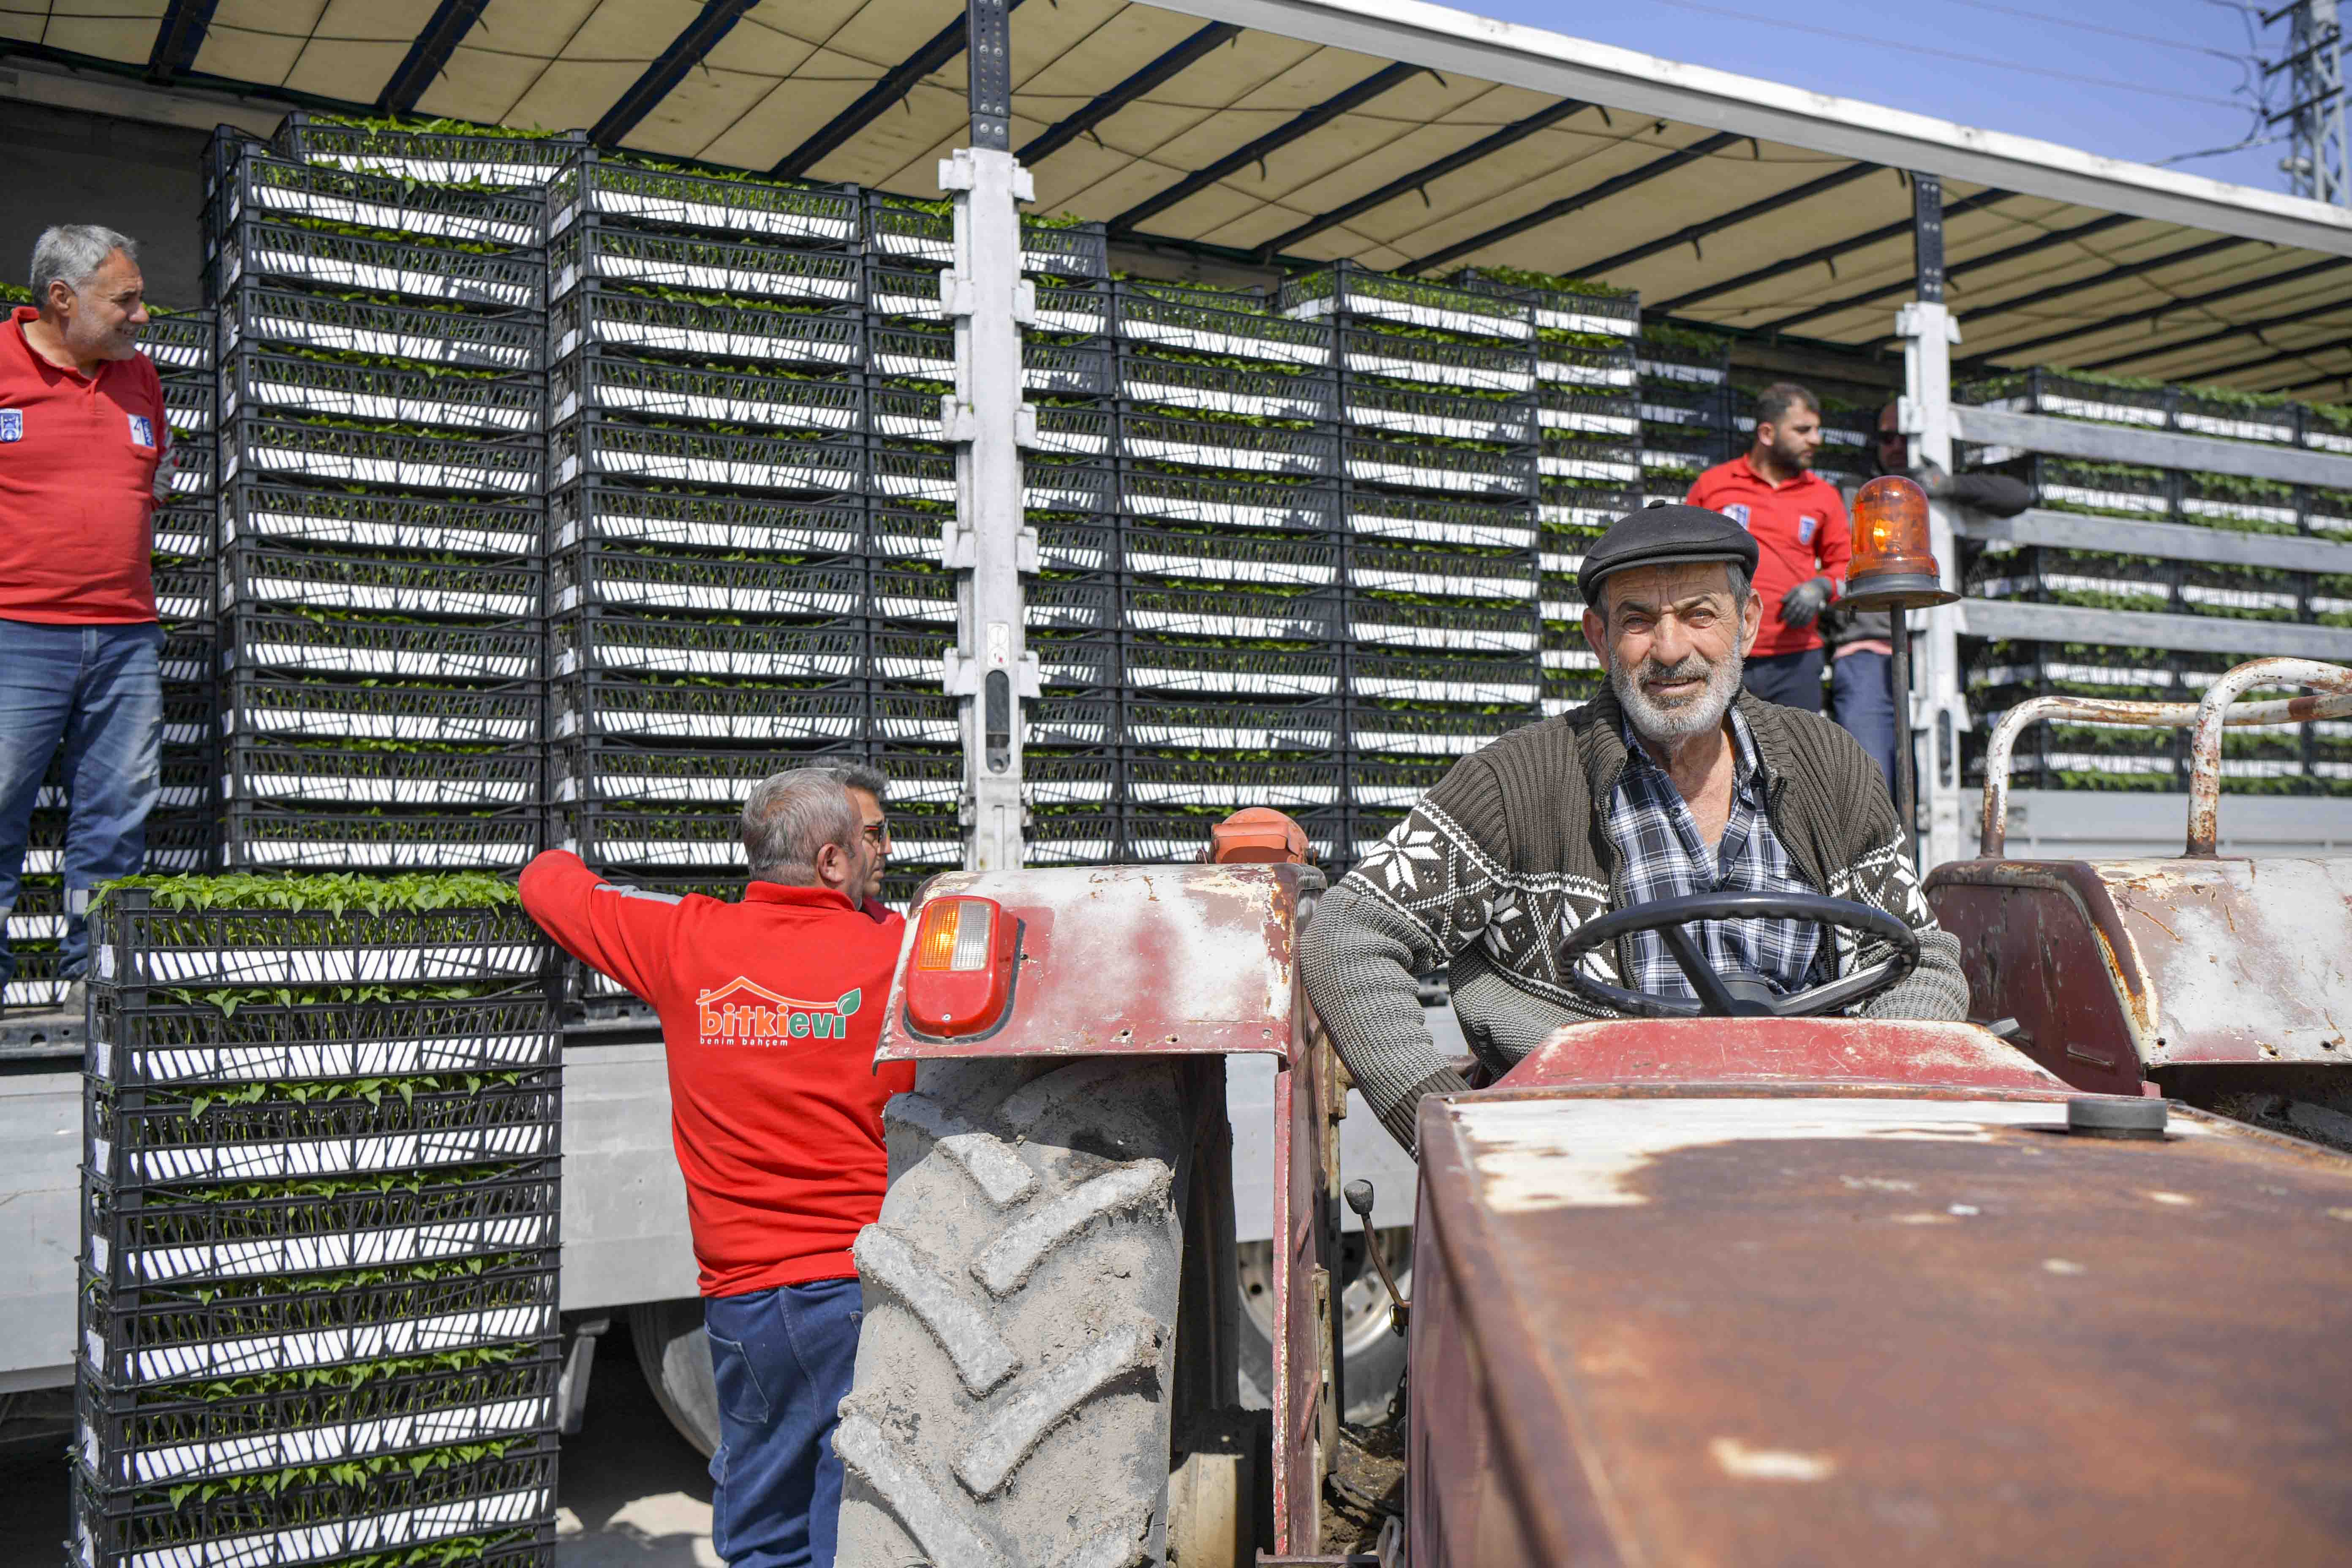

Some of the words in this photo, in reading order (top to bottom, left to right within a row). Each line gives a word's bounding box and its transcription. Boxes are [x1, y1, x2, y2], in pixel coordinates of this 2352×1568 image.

[700, 999, 846, 1039] bitkievi
[700, 1037, 735, 1045] benim
[742, 1037, 788, 1048] bahçem
